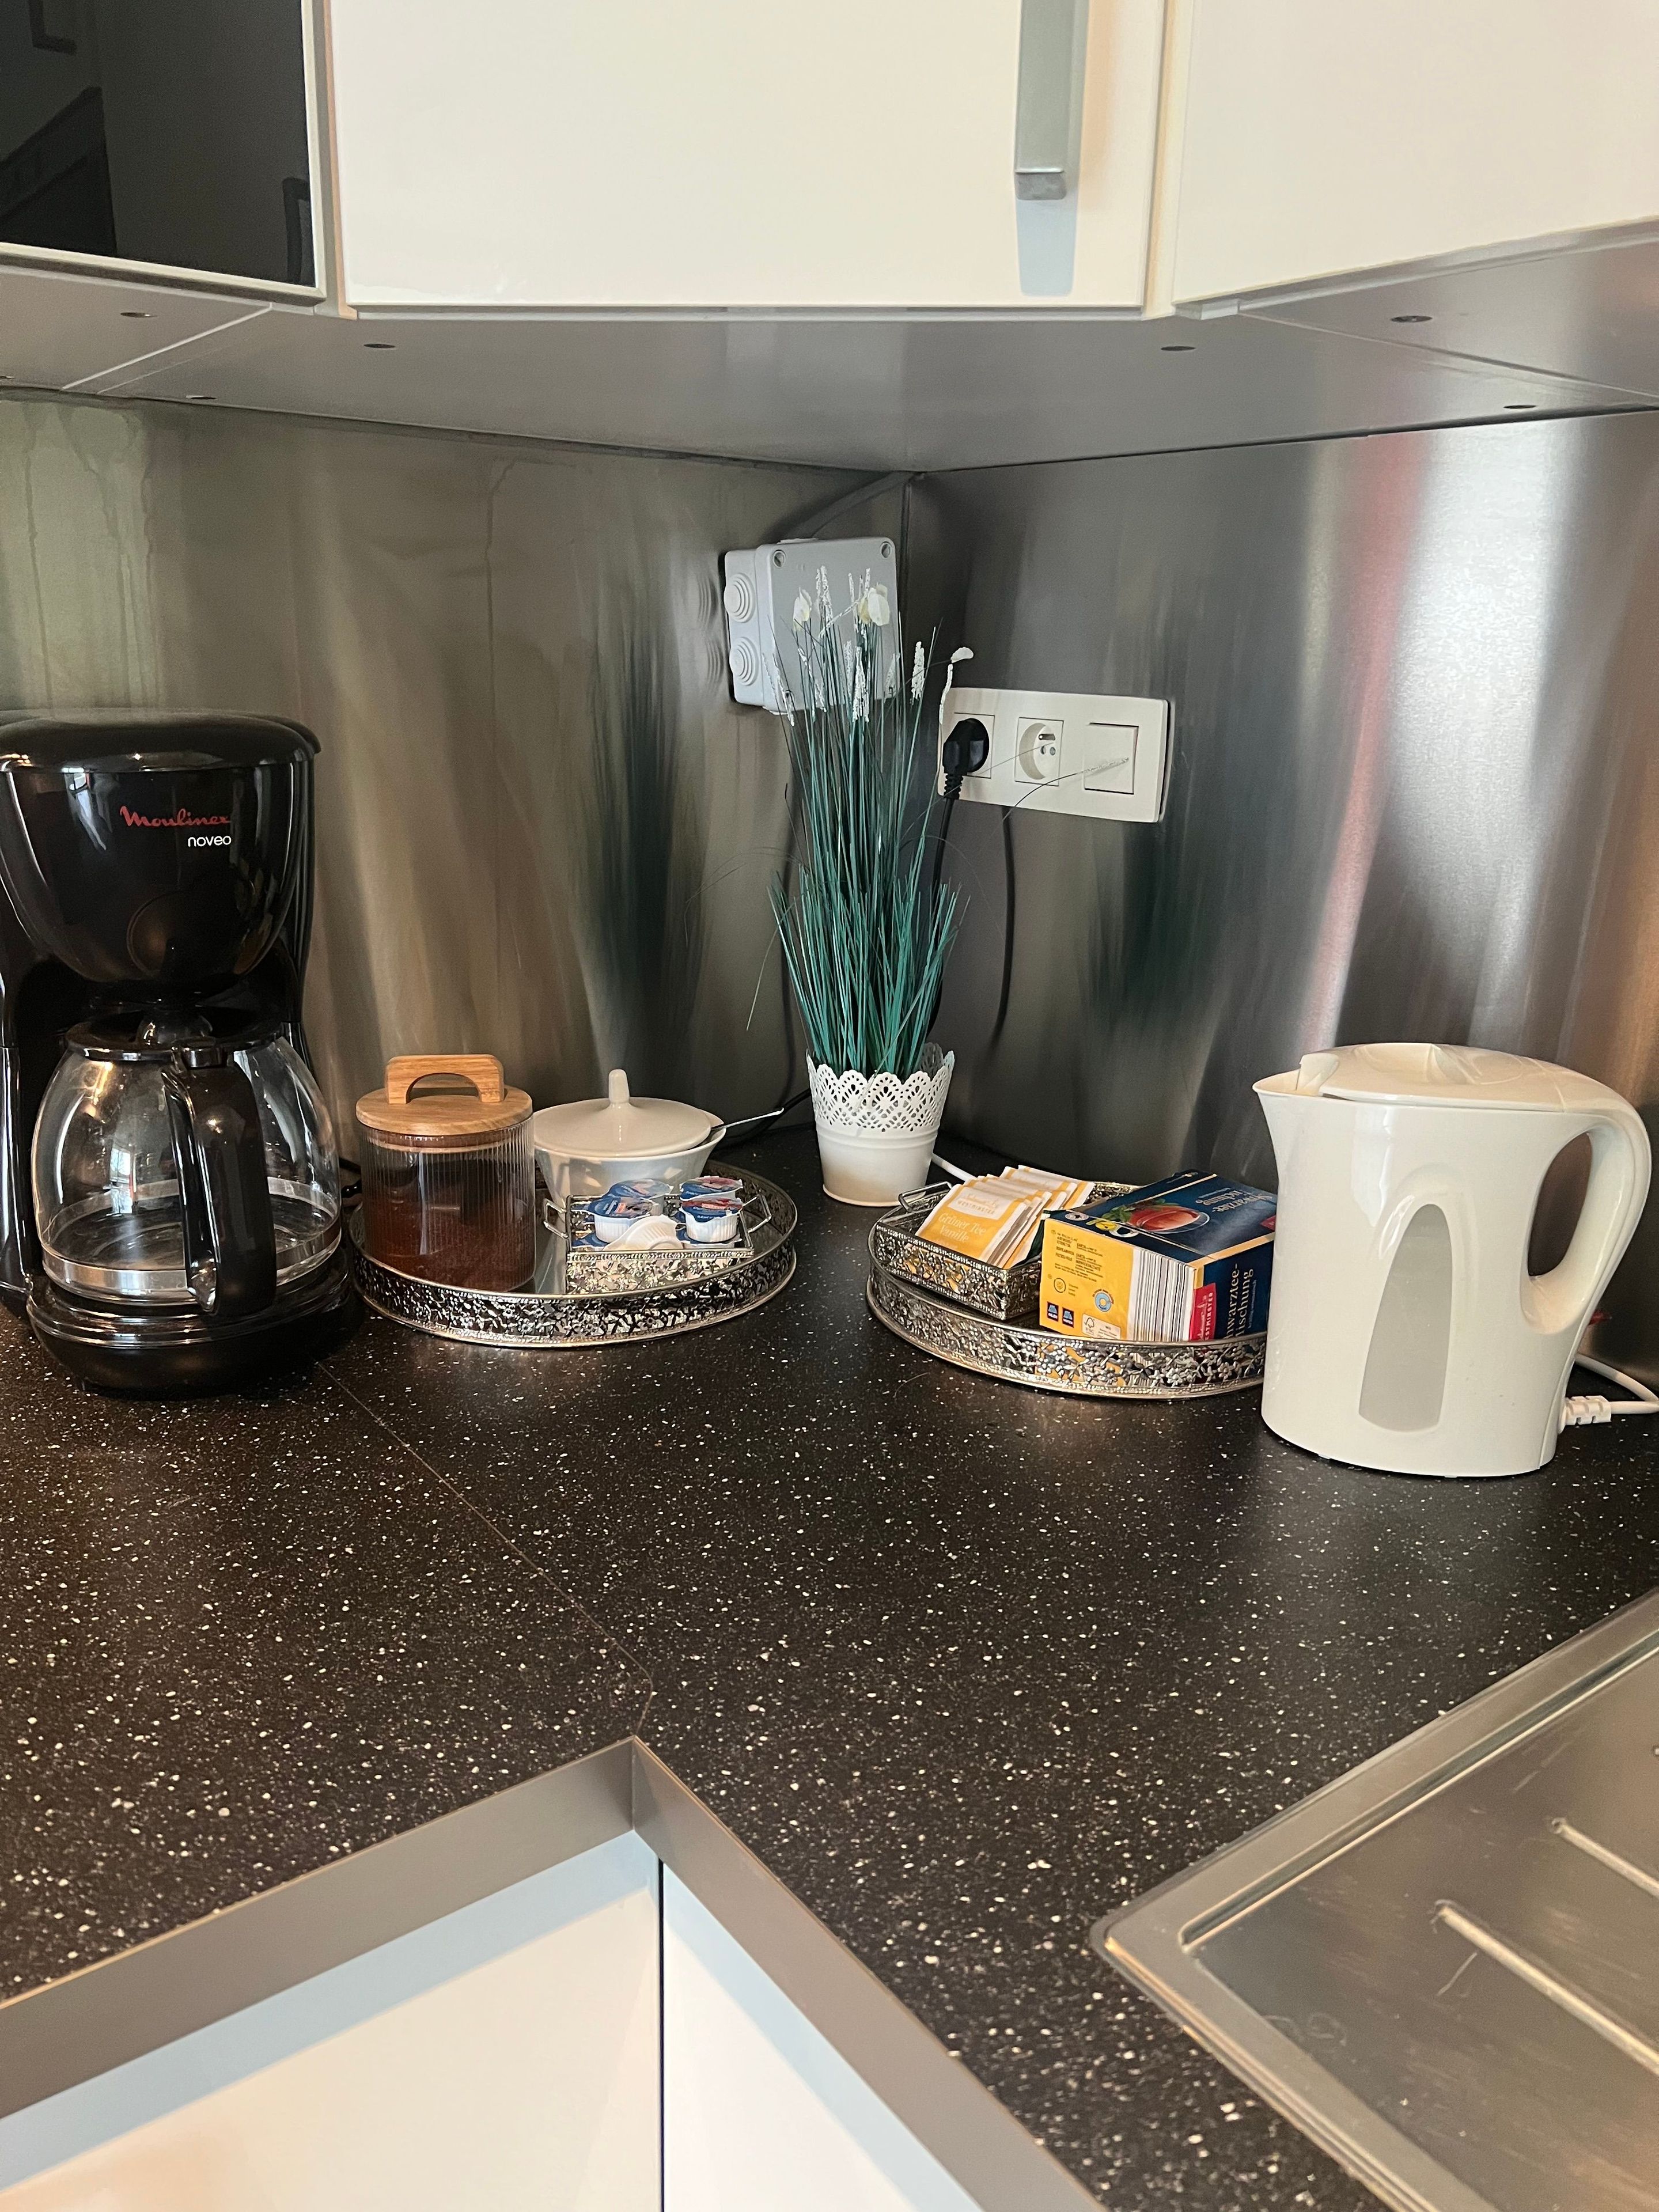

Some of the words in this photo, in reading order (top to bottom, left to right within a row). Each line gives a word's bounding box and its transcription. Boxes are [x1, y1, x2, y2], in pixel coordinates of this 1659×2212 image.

[120, 806, 230, 826] Moulinex
[188, 835, 232, 847] noveo
[938, 1213, 971, 1229] Grüner
[971, 1221, 987, 1236] Tee
[940, 1225, 969, 1243] Vanille
[1223, 1263, 1240, 1339] hwarztee-
